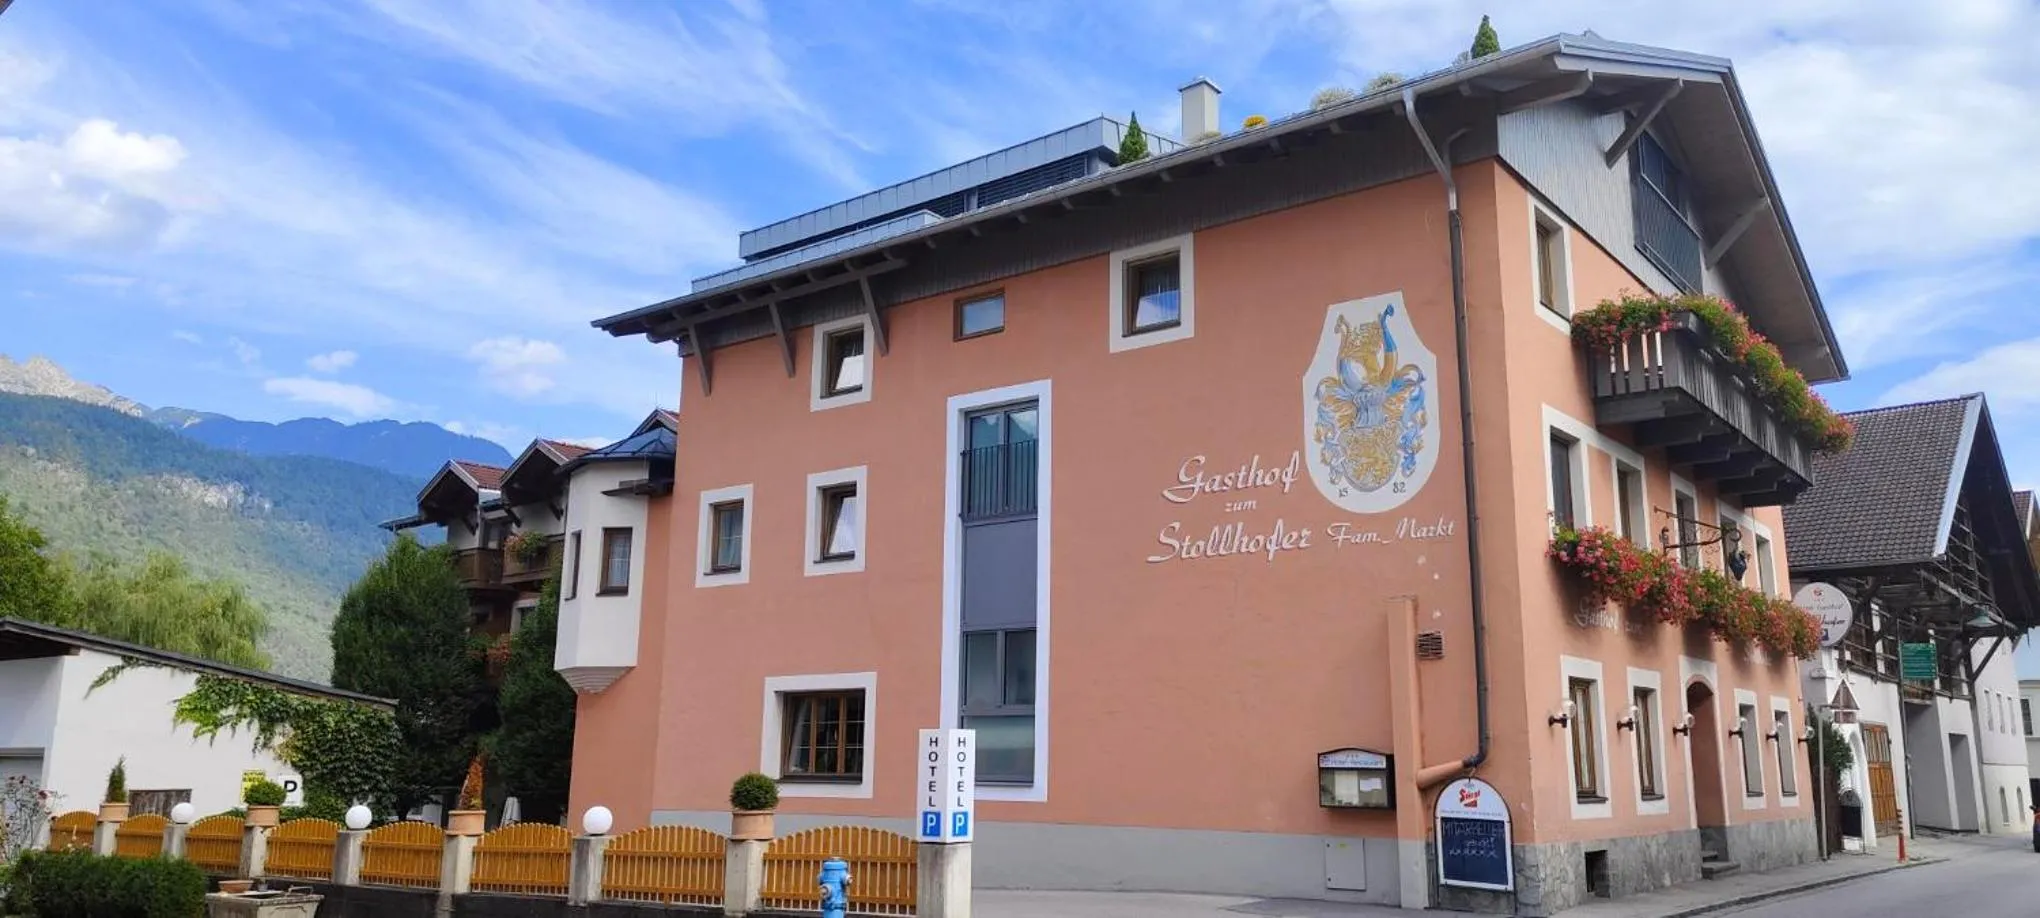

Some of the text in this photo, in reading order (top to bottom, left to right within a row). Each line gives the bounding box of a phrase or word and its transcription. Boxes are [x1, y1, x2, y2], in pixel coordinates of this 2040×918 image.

[1161, 450, 1300, 503] Gasthof
[1392, 481, 1407, 494] 82
[1224, 500, 1258, 512] zum
[1396, 514, 1455, 540] Markt
[1146, 518, 1312, 563] Stollhofer
[928, 736, 939, 808] HOTEL
[956, 736, 967, 808] HOTEL
[926, 813, 937, 835] P
[955, 813, 965, 835] P
